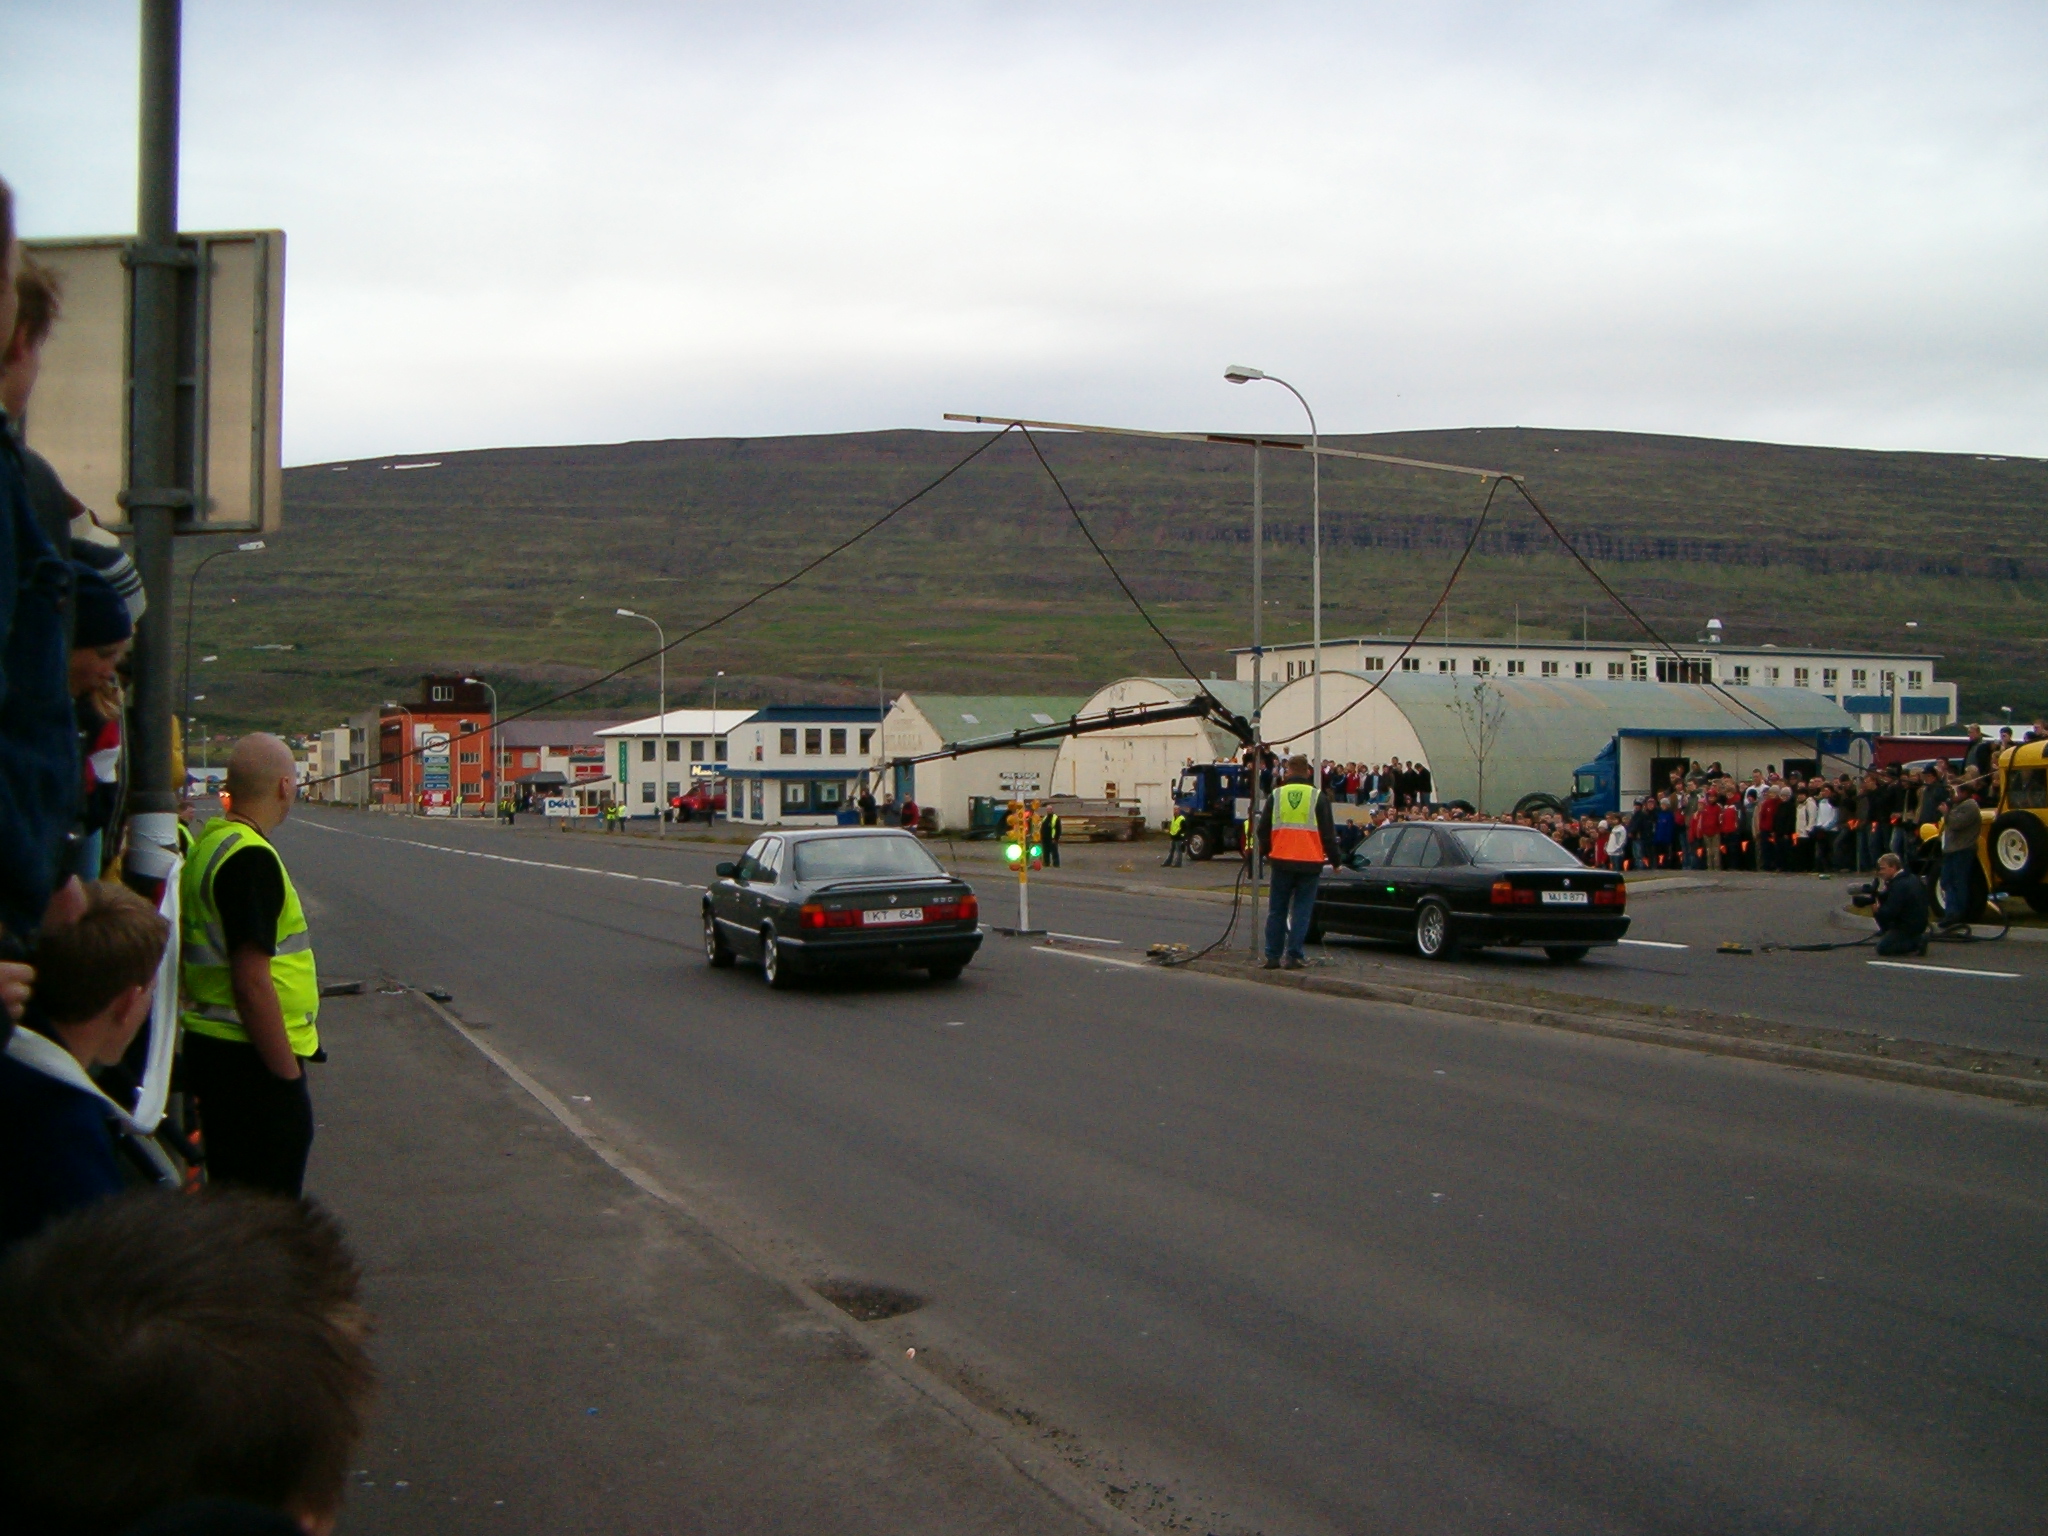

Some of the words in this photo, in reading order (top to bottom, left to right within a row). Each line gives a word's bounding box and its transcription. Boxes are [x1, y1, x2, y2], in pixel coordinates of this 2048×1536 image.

[548, 799, 577, 808] DELL
[872, 911, 889, 922] KT
[899, 908, 922, 920] 645
